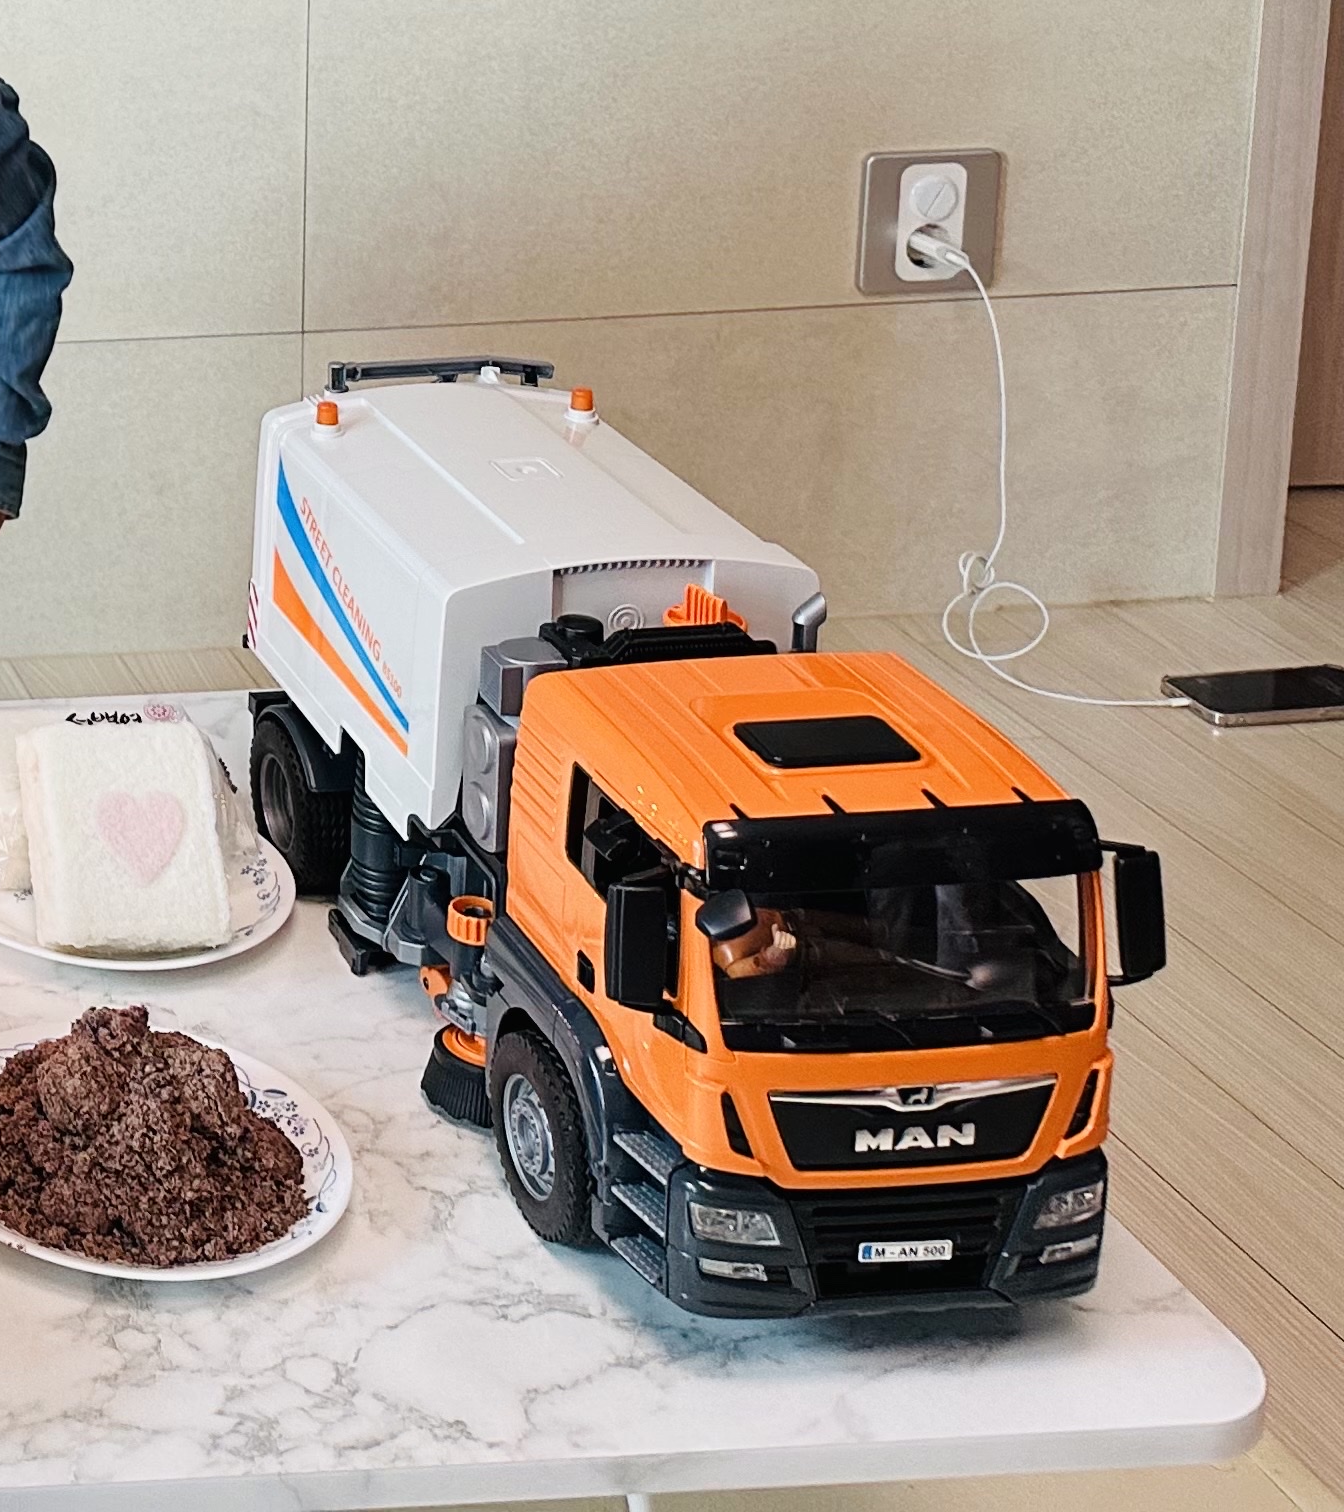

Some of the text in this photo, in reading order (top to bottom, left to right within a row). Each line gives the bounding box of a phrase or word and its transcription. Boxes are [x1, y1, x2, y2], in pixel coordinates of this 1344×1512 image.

[299, 496, 333, 570] STREET
[331, 566, 382, 662] CLEANING
[854, 1122, 976, 1153] MAN
